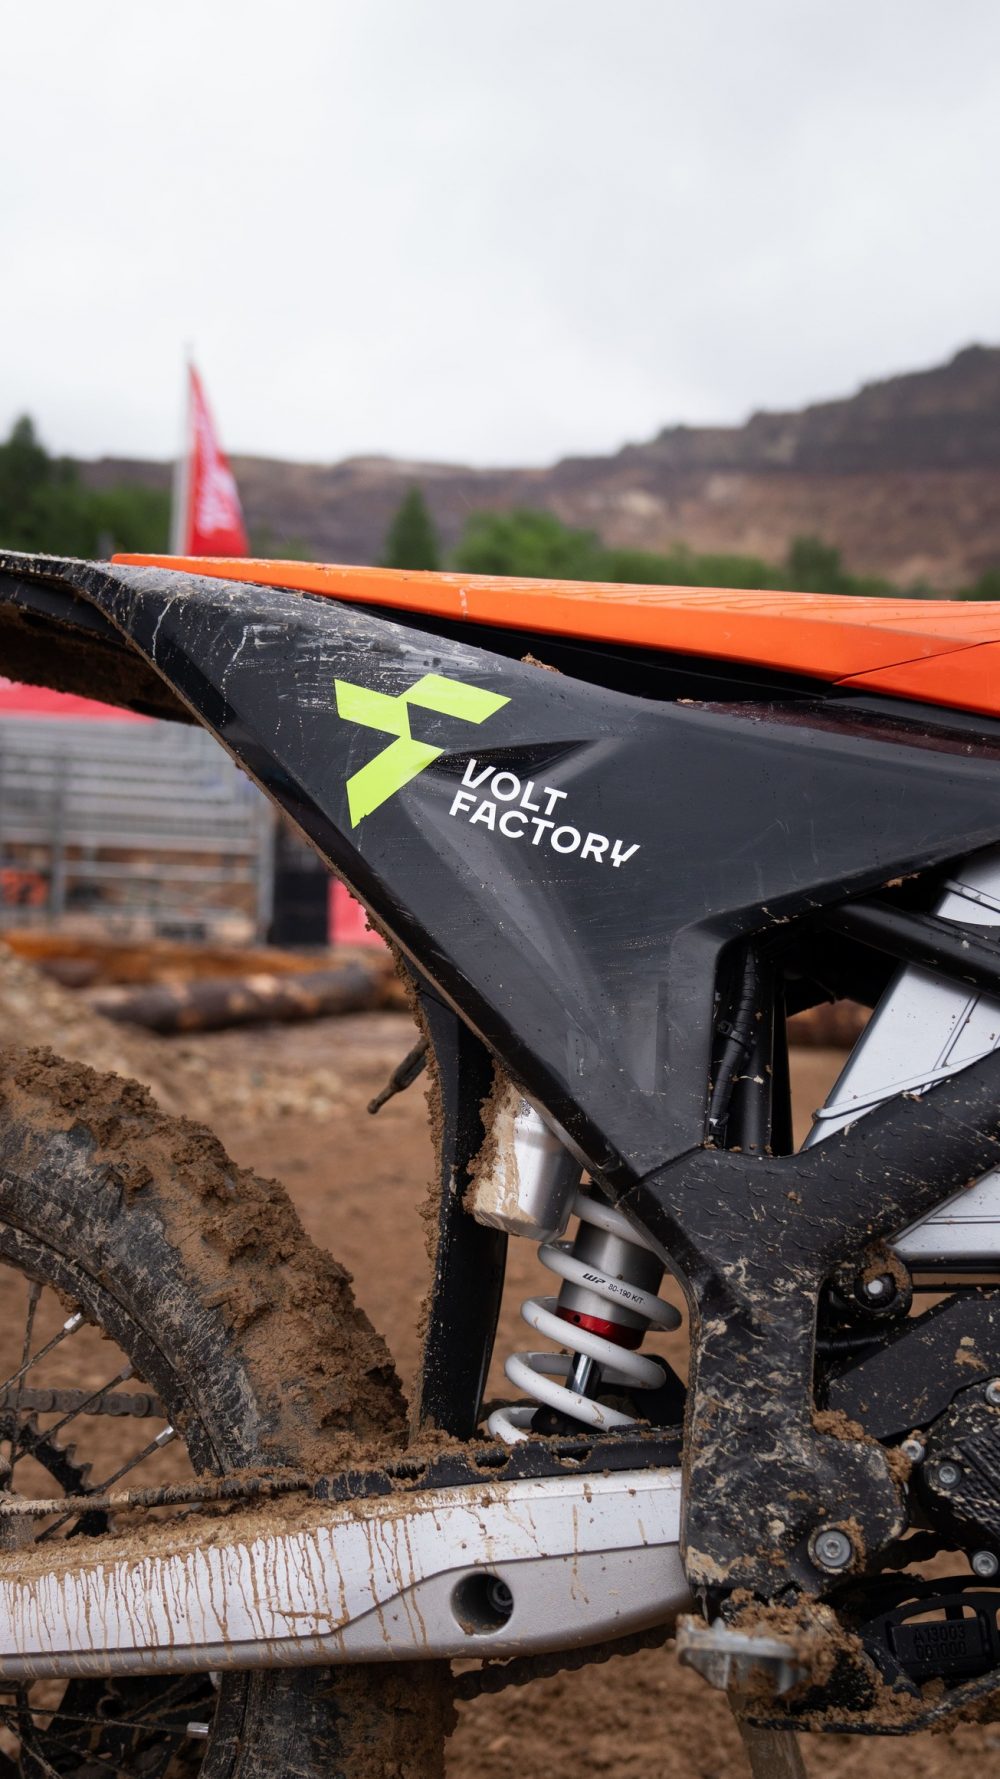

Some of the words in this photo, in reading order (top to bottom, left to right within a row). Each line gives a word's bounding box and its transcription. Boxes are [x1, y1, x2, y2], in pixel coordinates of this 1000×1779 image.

[461, 758, 568, 816] VOLT
[449, 789, 641, 868] FACTORY
[582, 1273, 606, 1284] WP
[607, 1283, 631, 1299] 80-190
